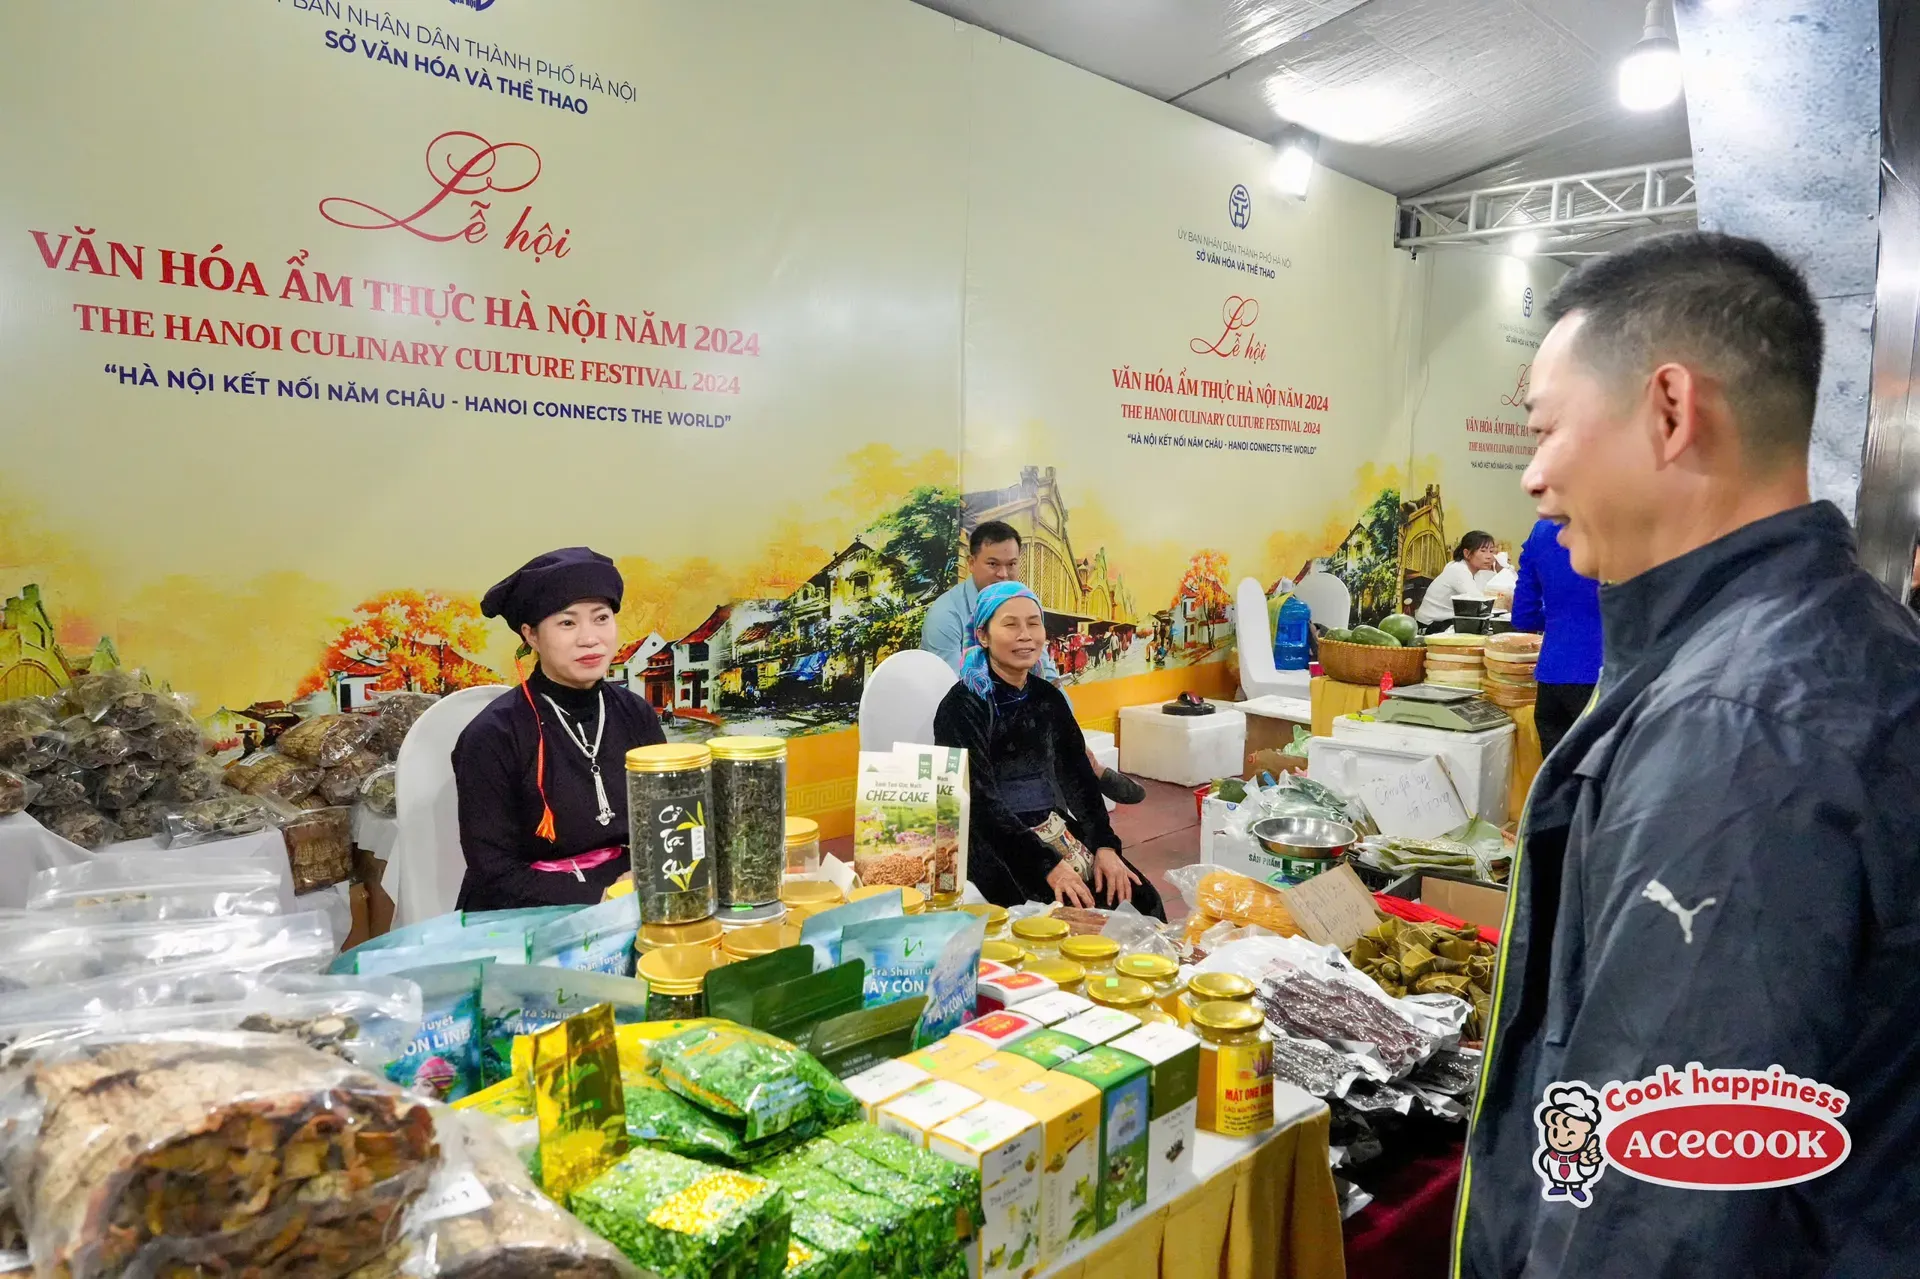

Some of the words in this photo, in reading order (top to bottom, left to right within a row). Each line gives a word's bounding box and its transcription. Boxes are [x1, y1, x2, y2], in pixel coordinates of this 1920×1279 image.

[325, 28, 356, 53] SỞ
[361, 39, 408, 68] VĂN
[414, 54, 460, 82] HÓA
[465, 67, 493, 91] VÀ
[496, 77, 534, 101] THỂ
[538, 87, 588, 114] THAO
[348, 5, 410, 39] NHÂN
[417, 25, 460, 53] DÂN
[465, 39, 531, 72] THÀNH
[536, 60, 575, 85] PHỐ
[580, 72, 604, 94] HÀ
[608, 80, 637, 103] NỘI
[318, 131, 542, 243] Lễ
[503, 205, 571, 263] hội
[1196, 248, 1206, 262] SỞ
[1207, 252, 1221, 265] VĂN
[1221, 256, 1235, 269] HÓA
[1236, 260, 1246, 272] VÀ
[1246, 262, 1258, 275] THỂ
[1259, 267, 1276, 279] THAO
[28, 225, 146, 281] VĂN
[158, 243, 269, 297] HÓA
[279, 249, 354, 308] ẨM
[363, 279, 475, 326] THỰC
[484, 289, 540, 332] HÀ
[547, 298, 608, 344] NỘI
[615, 310, 687, 349] NĂM
[694, 325, 760, 357] 2024
[73, 303, 155, 338] THE
[163, 314, 283, 351] HANOI
[290, 329, 449, 367] CULINARY
[455, 347, 575, 380] CULTURE
[580, 360, 687, 390] FESTIVAL
[692, 372, 740, 395] 2024
[1190, 295, 1259, 358] Lễ
[1244, 333, 1267, 364] hội
[167, 368, 214, 395] NỘI
[223, 371, 270, 395] KẾT
[277, 376, 319, 400] NỐI
[328, 381, 379, 404] NĂM
[386, 388, 445, 409] CHÂU
[465, 396, 527, 415] HANOI
[533, 401, 627, 422] CONNECTS
[631, 408, 663, 425] THE
[1112, 365, 1142, 390] VĂN
[1145, 368, 1174, 394] HÓA
[1177, 367, 1198, 397] ẨM
[1201, 379, 1235, 403] THỰC
[1236, 380, 1254, 403] HÀ
[1256, 383, 1277, 408] NỘI
[1278, 387, 1303, 409] NĂM
[1304, 394, 1329, 412] 2024
[1121, 404, 1142, 419] THE
[1144, 406, 1177, 422] HANOI
[1178, 409, 1225, 427] CULINARY
[1226, 414, 1265, 430] CULTURE
[1266, 417, 1301, 433] FESTIVAL
[1303, 421, 1321, 435] 2024
[1465, 416, 1478, 432] VĂN
[1480, 416, 1493, 433] HÓA
[1143, 434, 1157, 447] NỘI
[1158, 433, 1172, 446] KẾT
[1173, 434, 1186, 447] NỐI
[1187, 435, 1204, 448] NĂM
[1205, 437, 1223, 450] CHÂU
[1228, 440, 1249, 451] HANOI
[1249, 441, 1281, 453] CONNECTS
[1282, 444, 1293, 454] THE
[866, 789, 897, 802] CHEZ
[899, 791, 929, 803] CAKE
[890, 966, 916, 976] Shan
[892, 977, 925, 992] CÔN
[1225, 1087, 1243, 1104] MẬT
